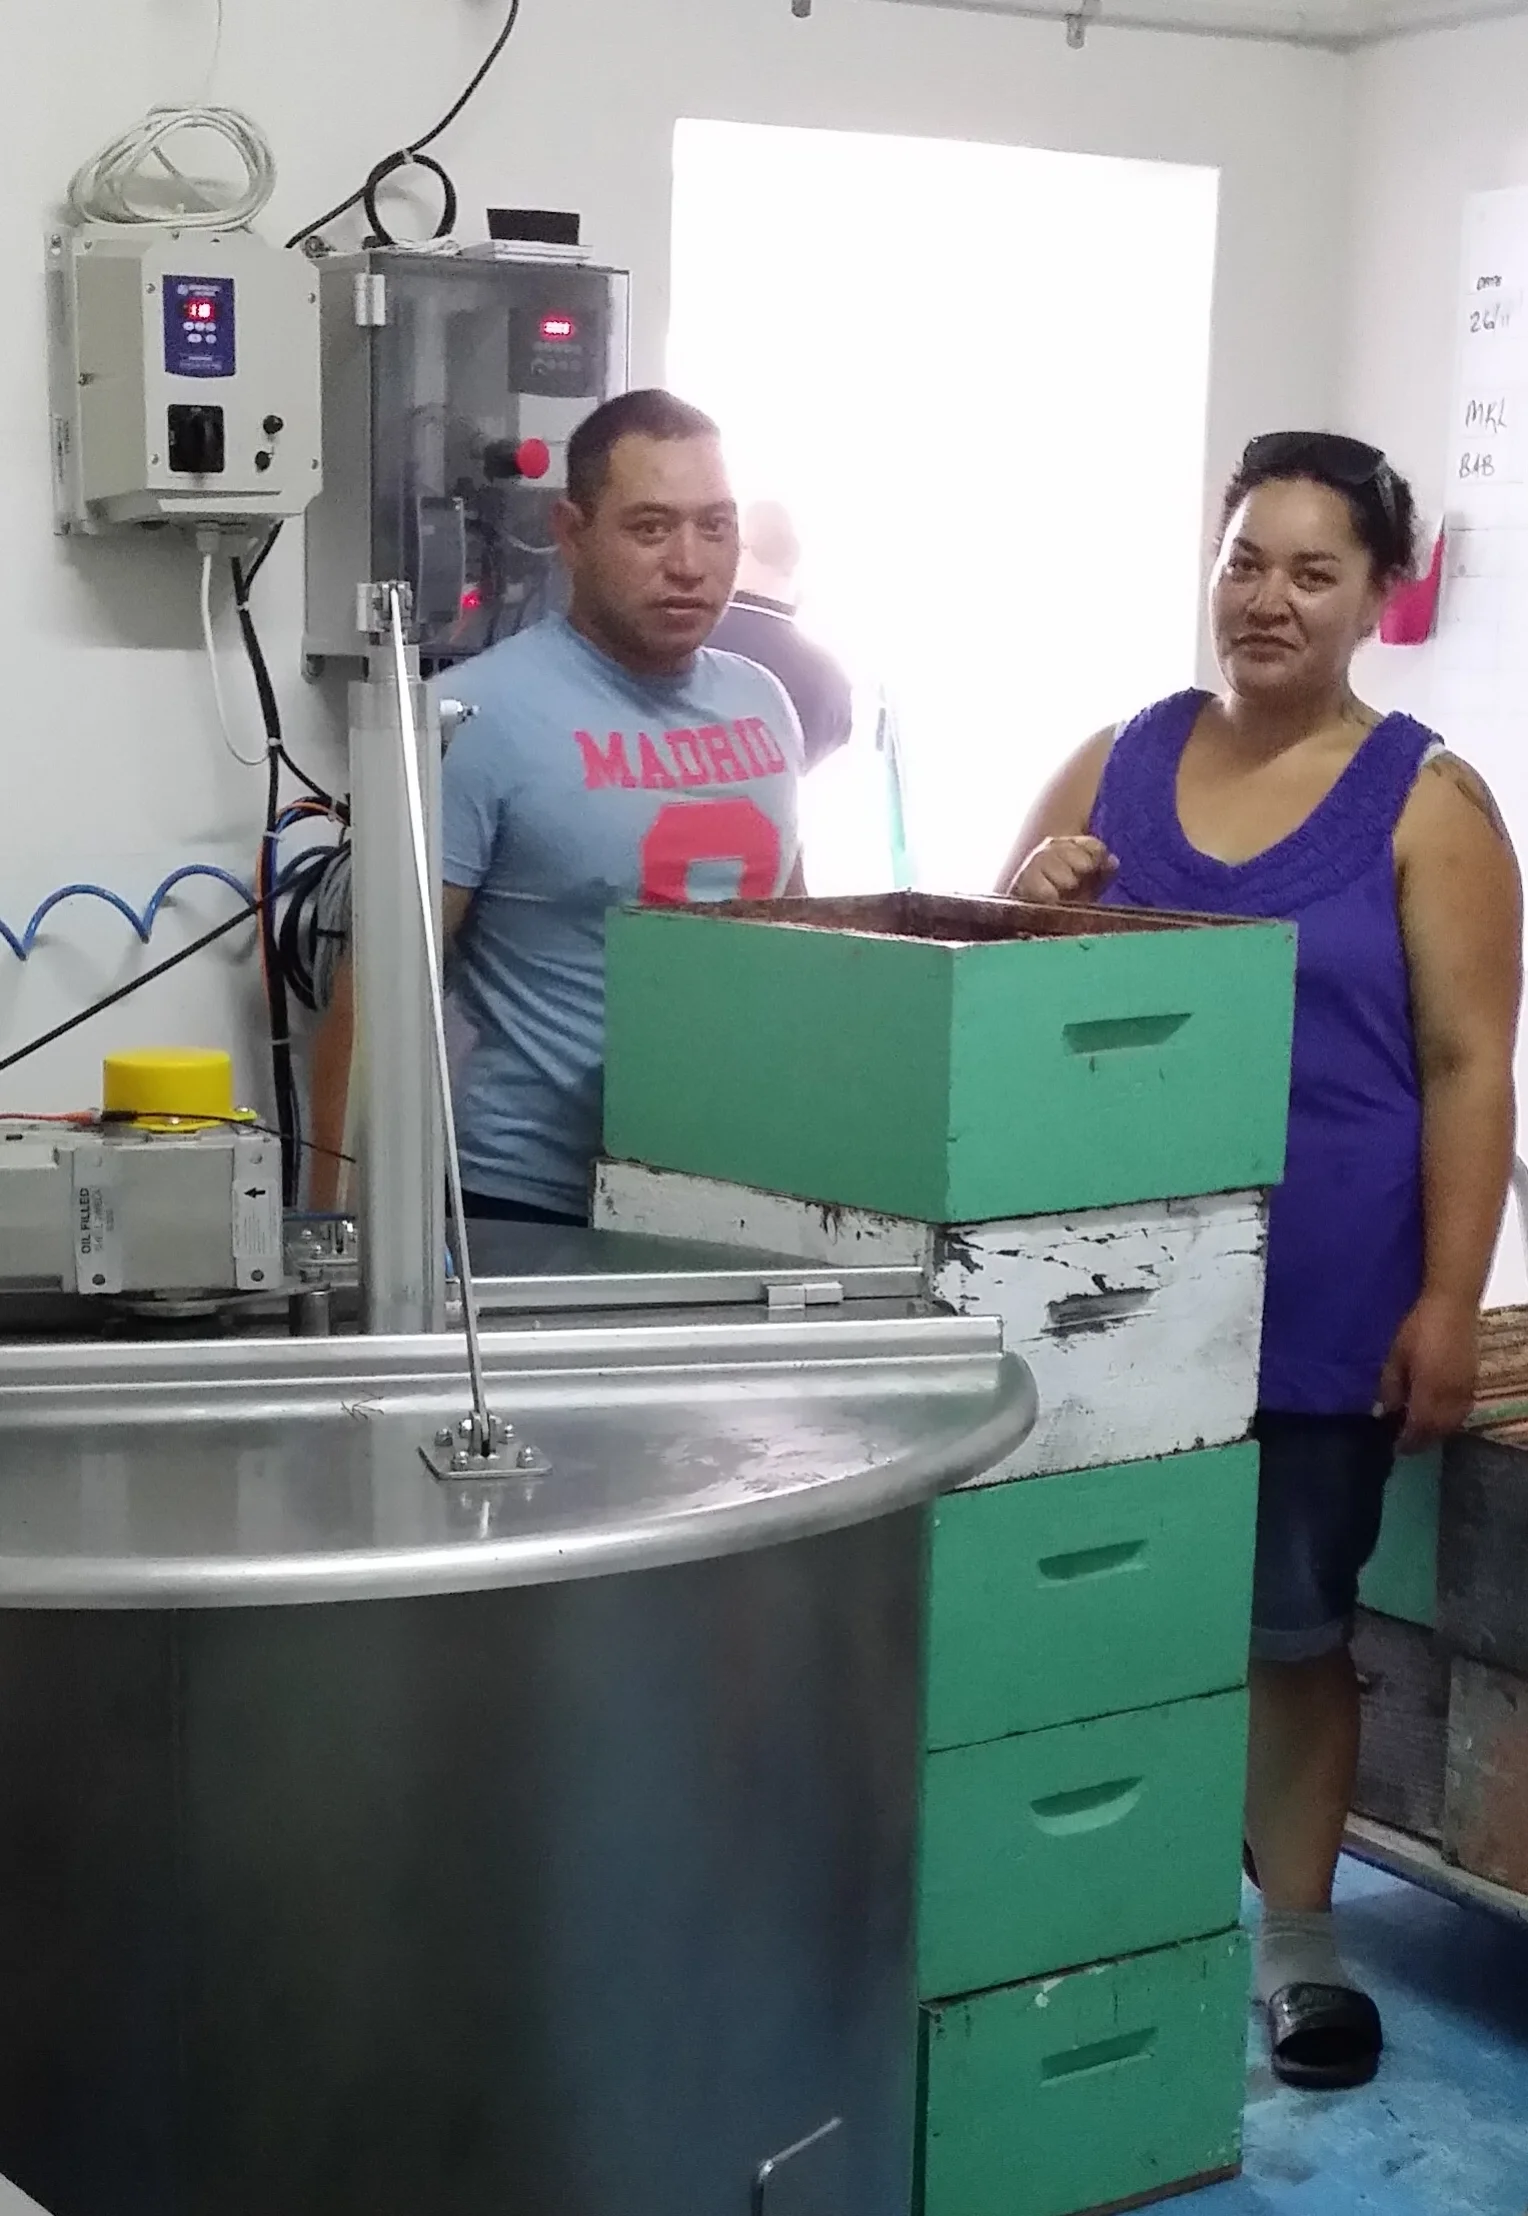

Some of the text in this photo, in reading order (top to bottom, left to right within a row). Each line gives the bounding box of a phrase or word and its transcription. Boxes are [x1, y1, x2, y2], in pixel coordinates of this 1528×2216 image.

[573, 716, 787, 791] MADRID
[79, 1187, 91, 1254] OIL FILLED
